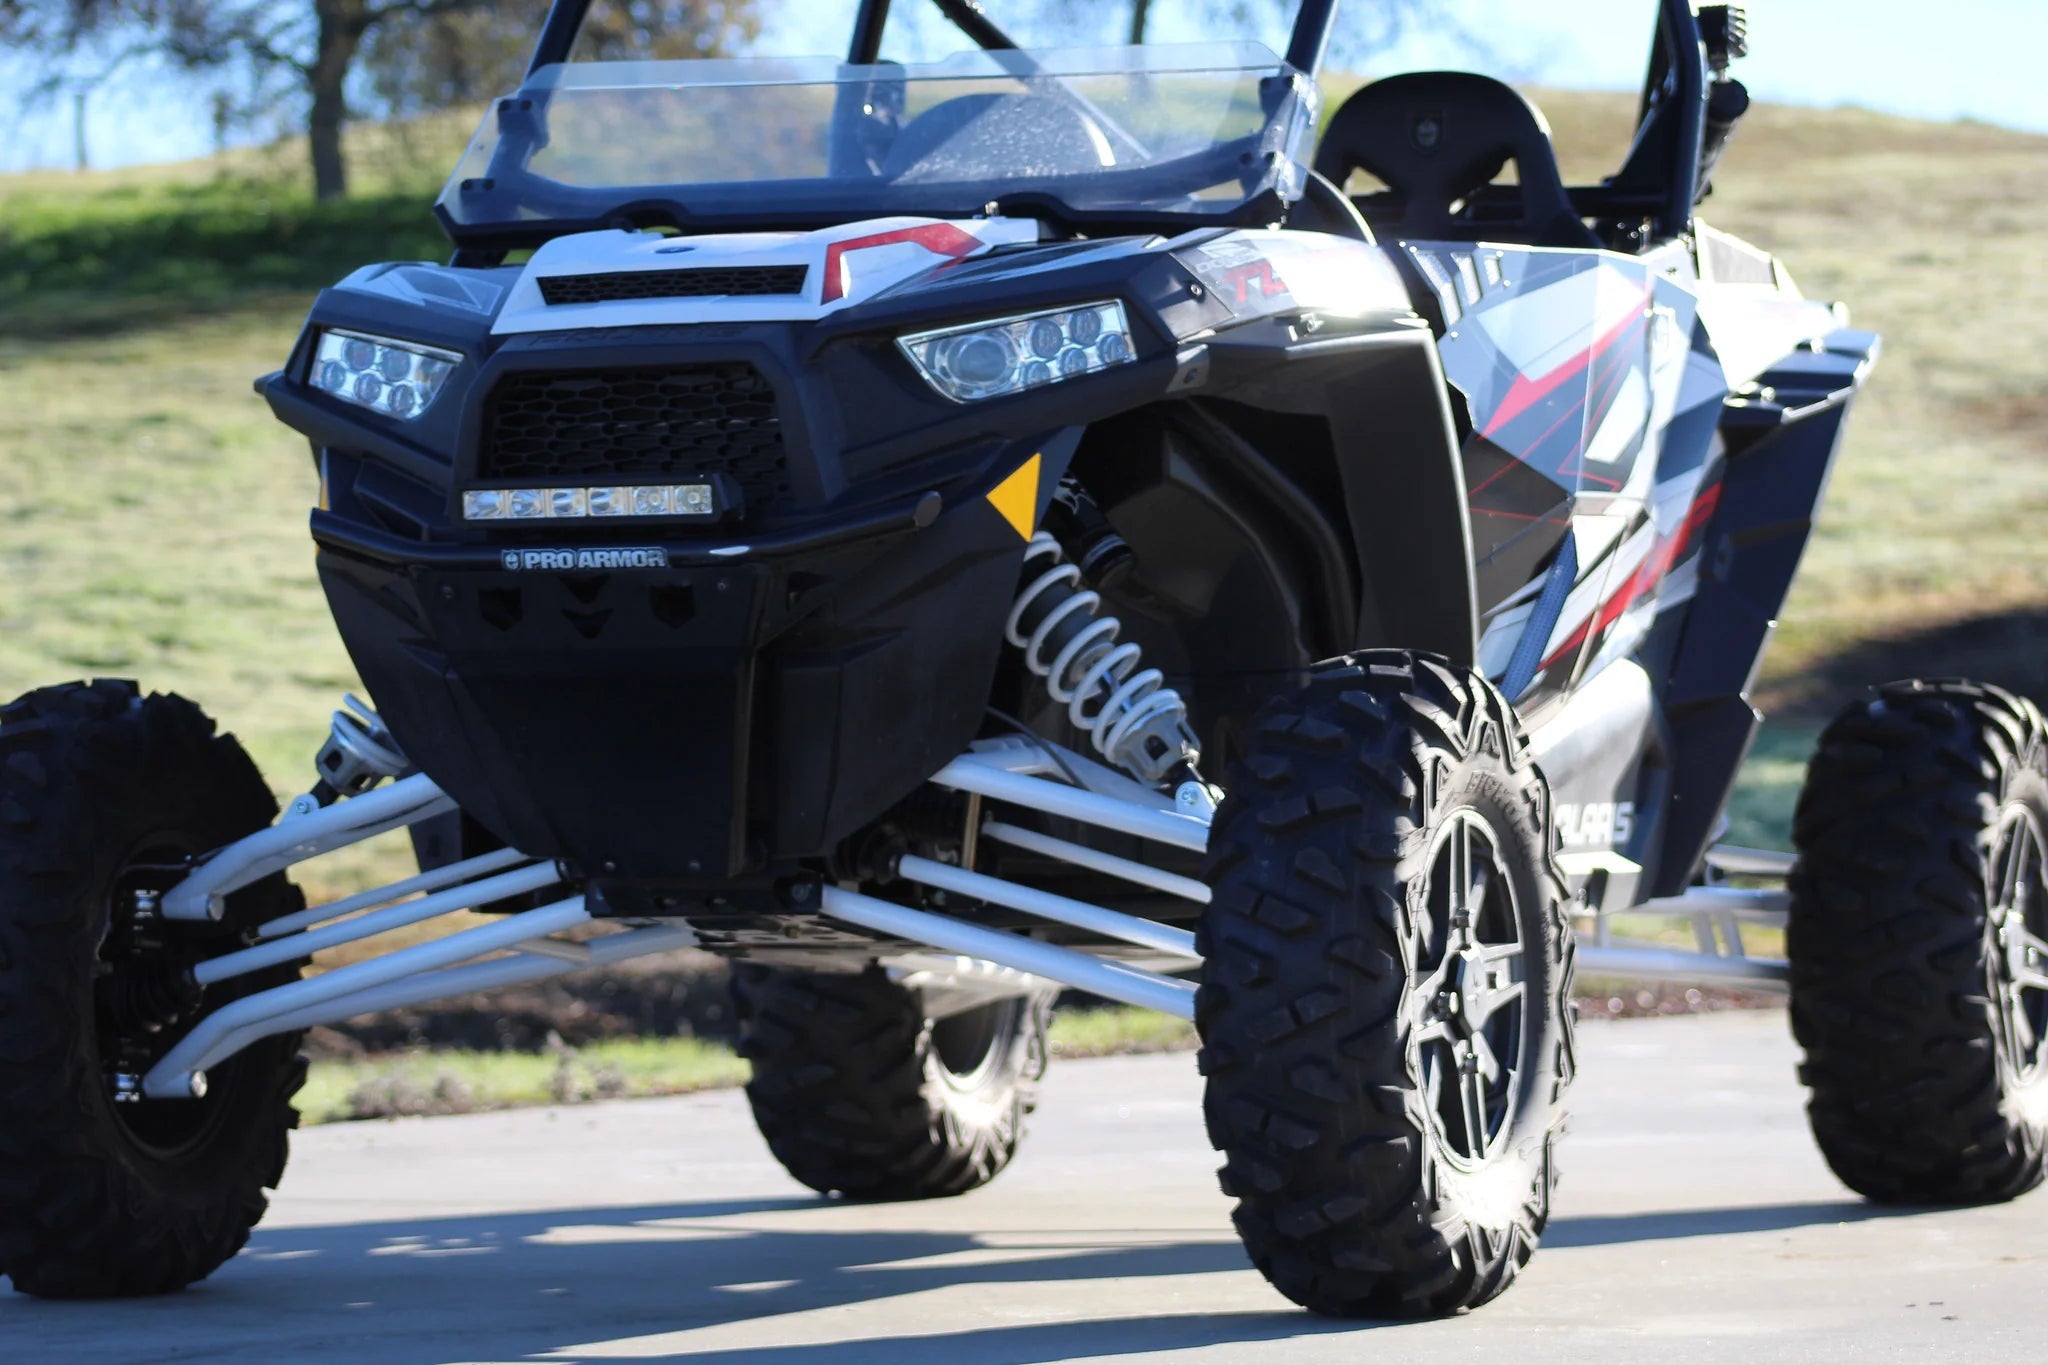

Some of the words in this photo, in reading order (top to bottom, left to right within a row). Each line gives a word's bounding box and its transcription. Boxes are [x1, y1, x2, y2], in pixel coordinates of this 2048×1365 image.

[524, 552, 574, 569] PRO
[578, 550, 665, 568] ARMOR
[1555, 802, 1634, 844] OLARIS
